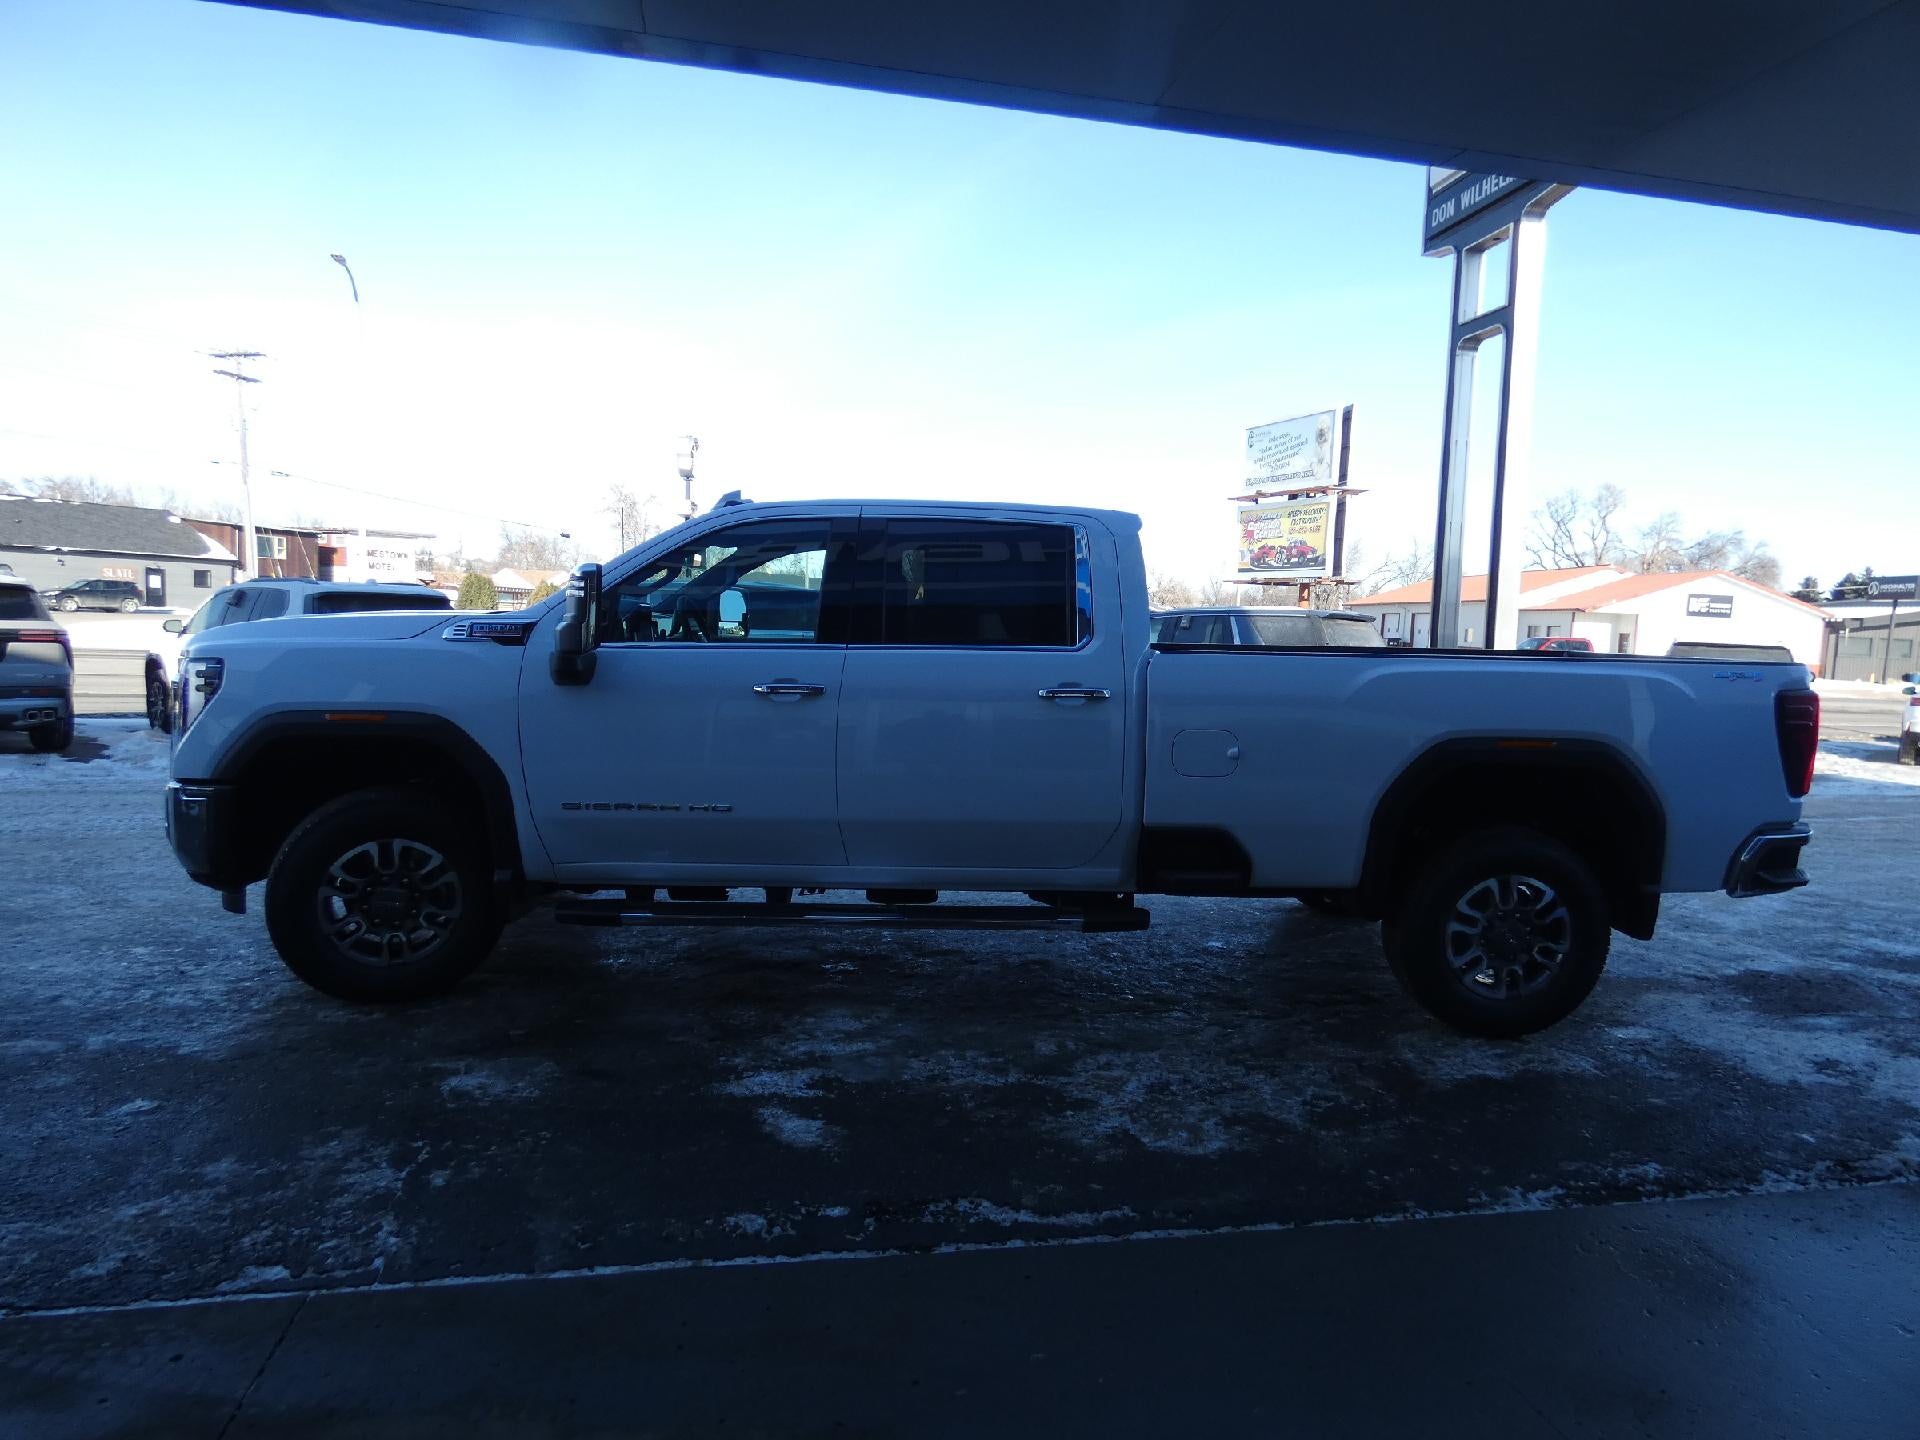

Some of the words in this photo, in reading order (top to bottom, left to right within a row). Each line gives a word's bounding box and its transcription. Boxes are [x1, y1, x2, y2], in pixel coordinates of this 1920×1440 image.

[1431, 198, 1455, 228] DON
[1460, 174, 1517, 211] WILHEL
[561, 802, 681, 811] SIERRA
[689, 804, 733, 812] HD
